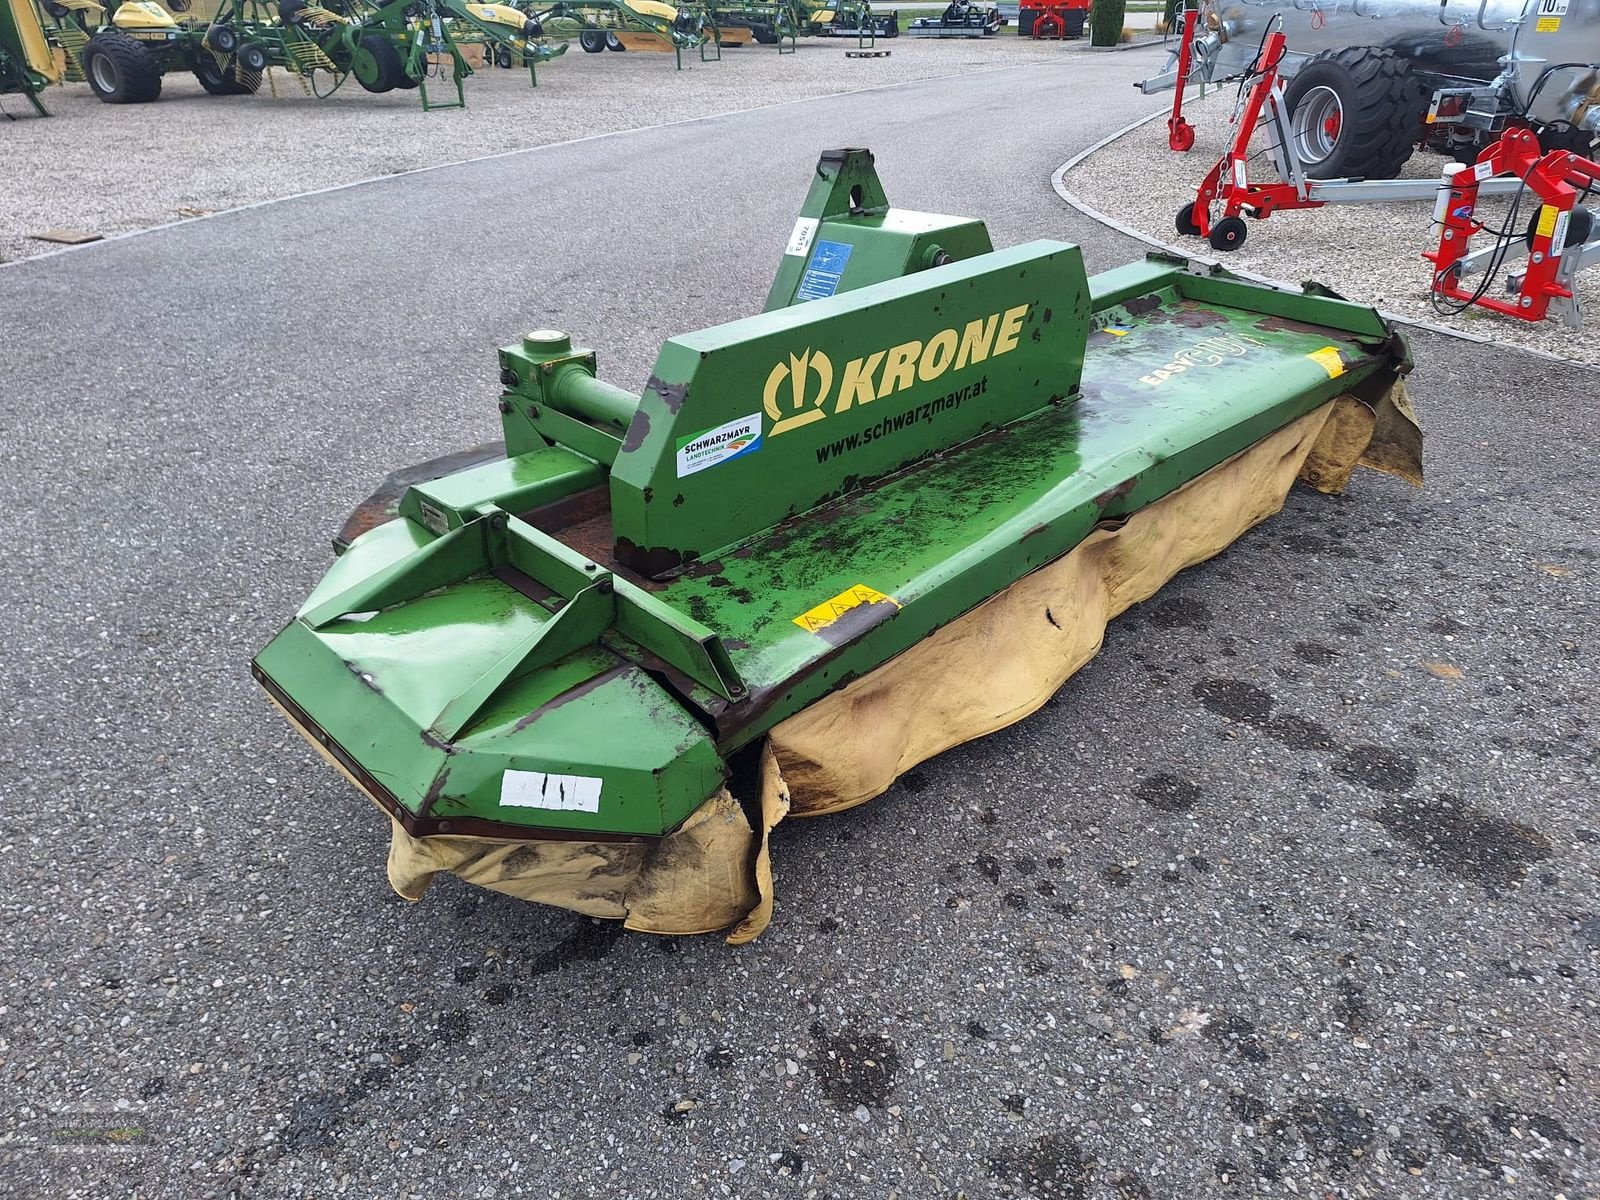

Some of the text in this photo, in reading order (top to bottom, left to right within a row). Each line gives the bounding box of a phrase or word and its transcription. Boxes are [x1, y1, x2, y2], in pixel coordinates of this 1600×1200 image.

[795, 226, 810, 251] 70513
[835, 303, 1030, 414] KRONE
[815, 374, 988, 464] www.schwarzmayr.at
[684, 425, 751, 454] SCHWARZMAYR
[686, 444, 725, 462] LANDTECHNIK
